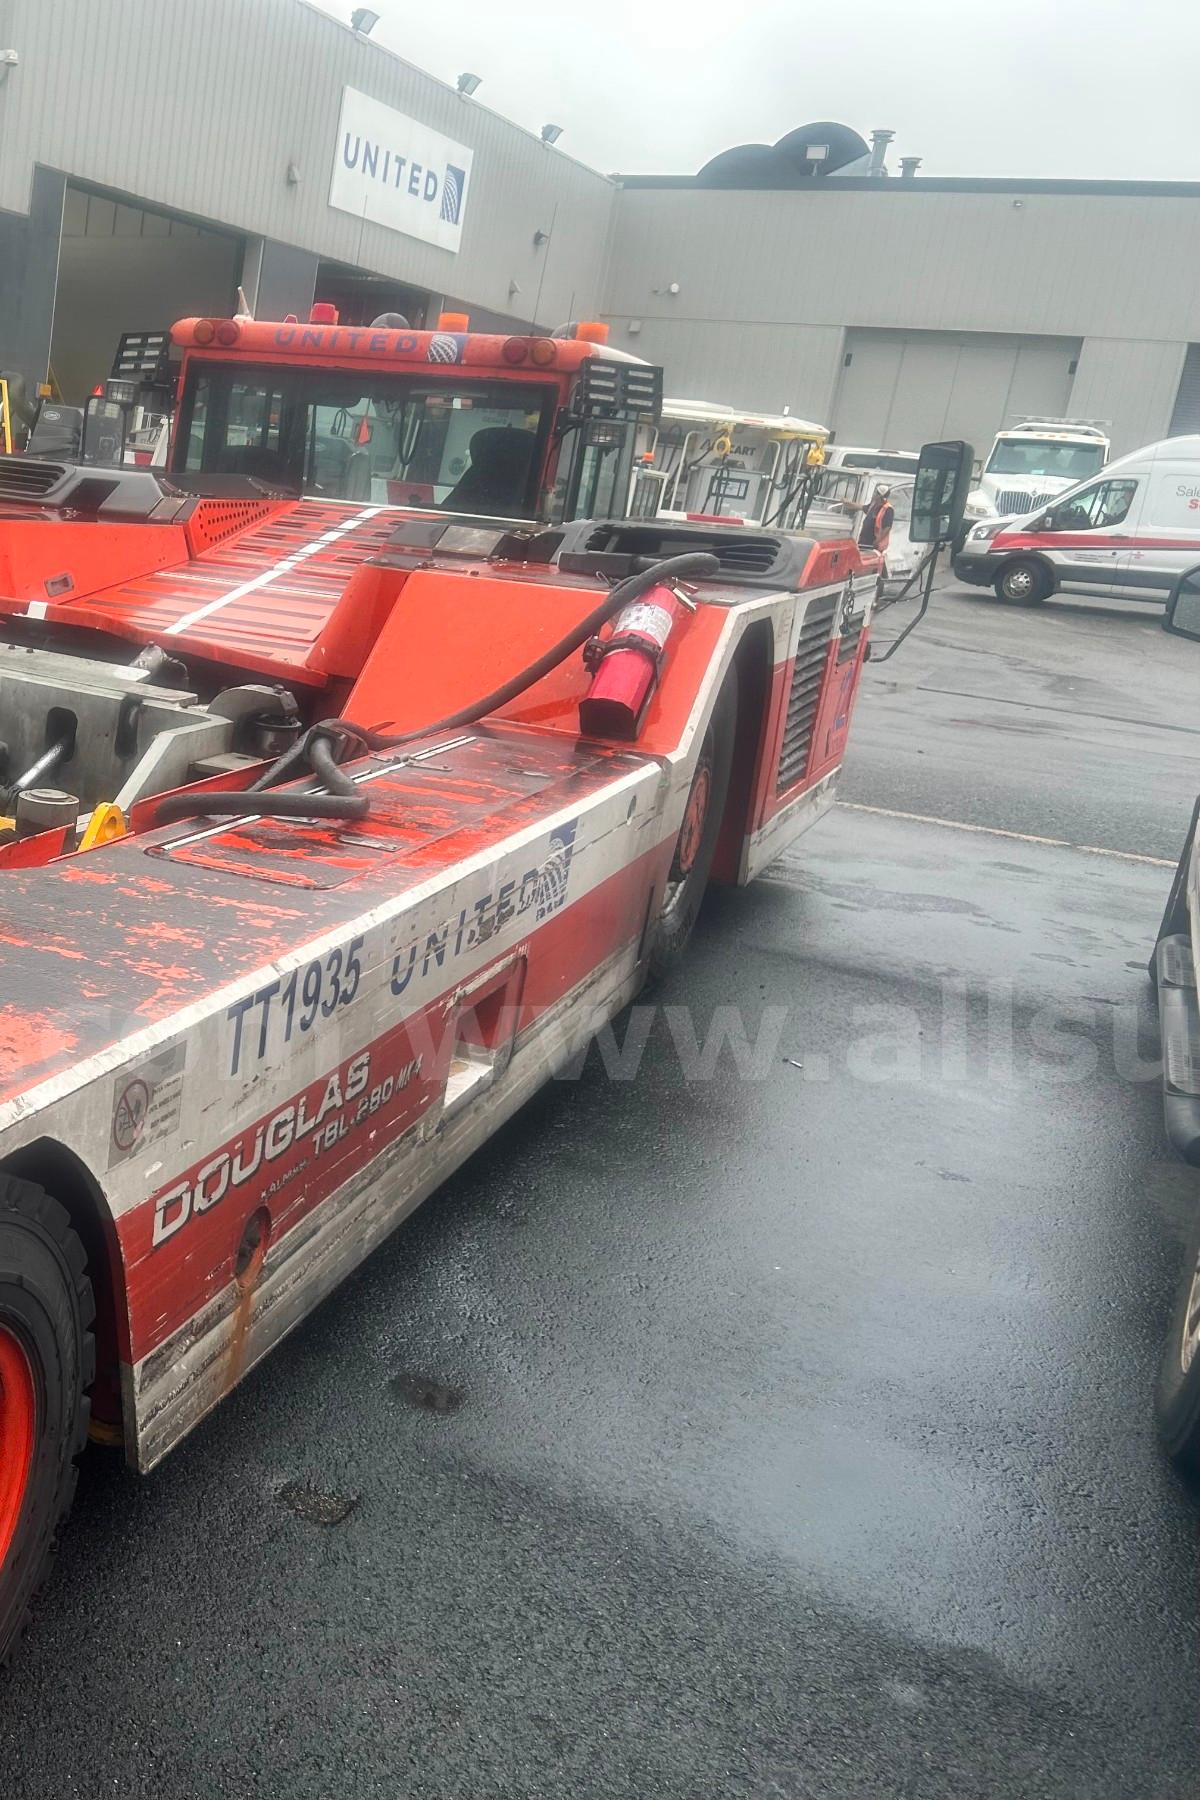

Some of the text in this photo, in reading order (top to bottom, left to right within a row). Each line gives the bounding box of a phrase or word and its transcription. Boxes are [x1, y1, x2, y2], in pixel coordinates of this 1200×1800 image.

[343, 132, 439, 203] UNITED
[274, 328, 418, 353] UNITED
[390, 867, 539, 996] UNITED
[227, 935, 365, 1077] TT1935
[152, 1051, 371, 1248] DOUGLAS
